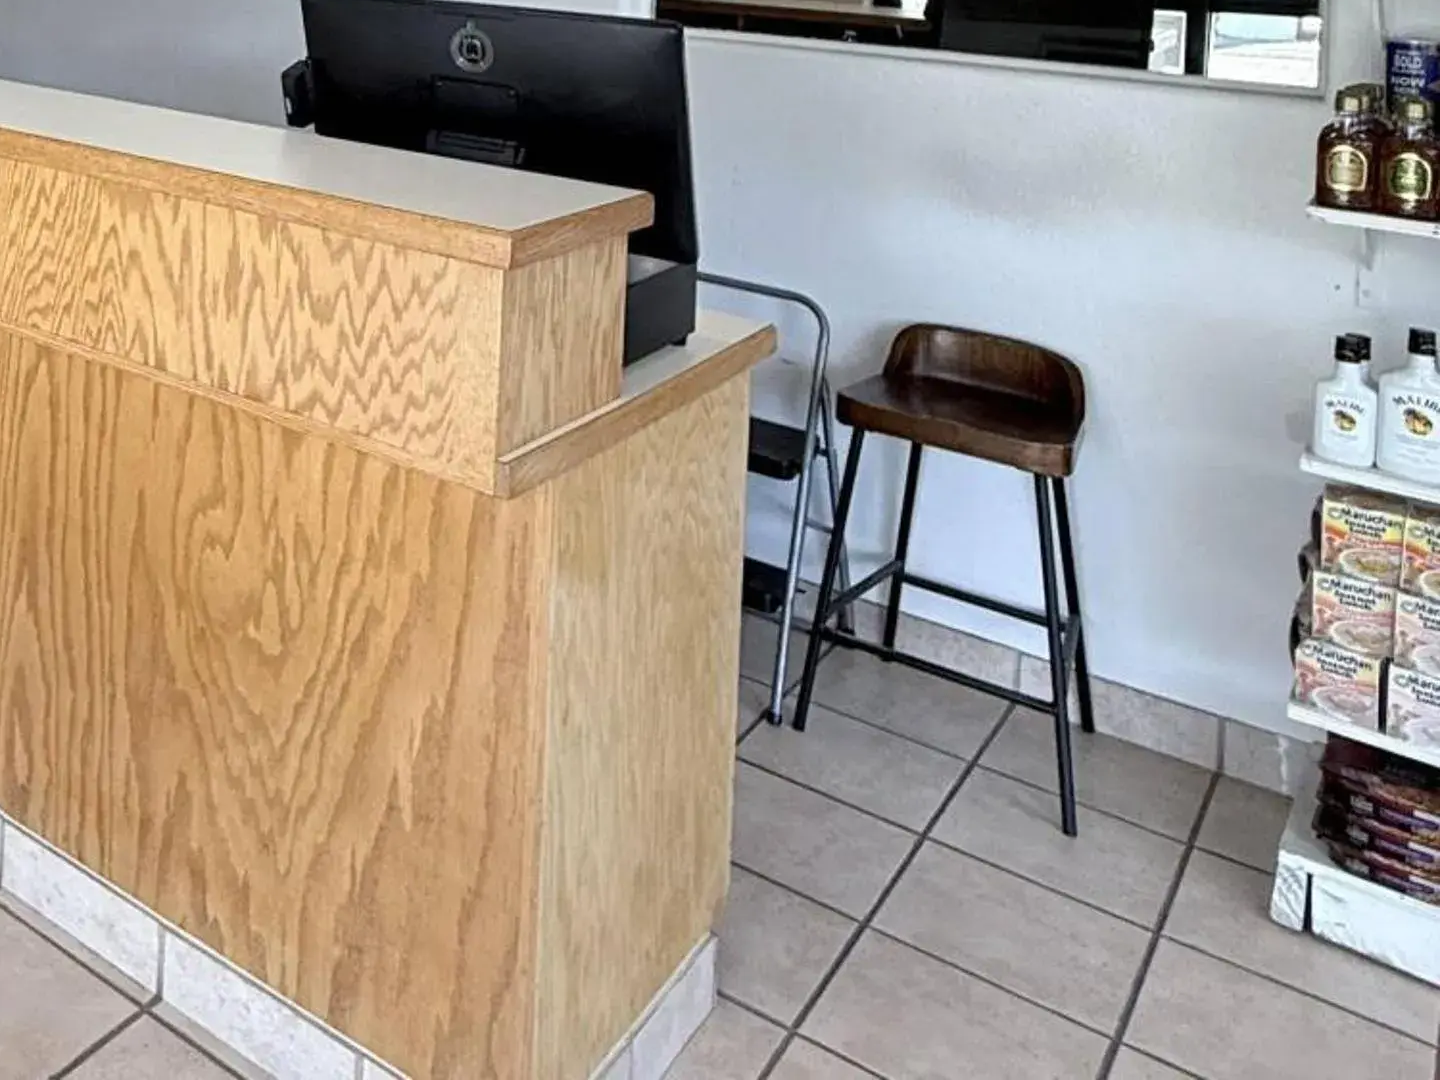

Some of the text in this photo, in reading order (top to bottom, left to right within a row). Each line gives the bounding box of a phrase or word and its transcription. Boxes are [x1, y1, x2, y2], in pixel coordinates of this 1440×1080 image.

[1340, 507, 1402, 530] Maruchan
[1329, 577, 1392, 602] Maruchan
[1312, 644, 1374, 672] Maruchan
